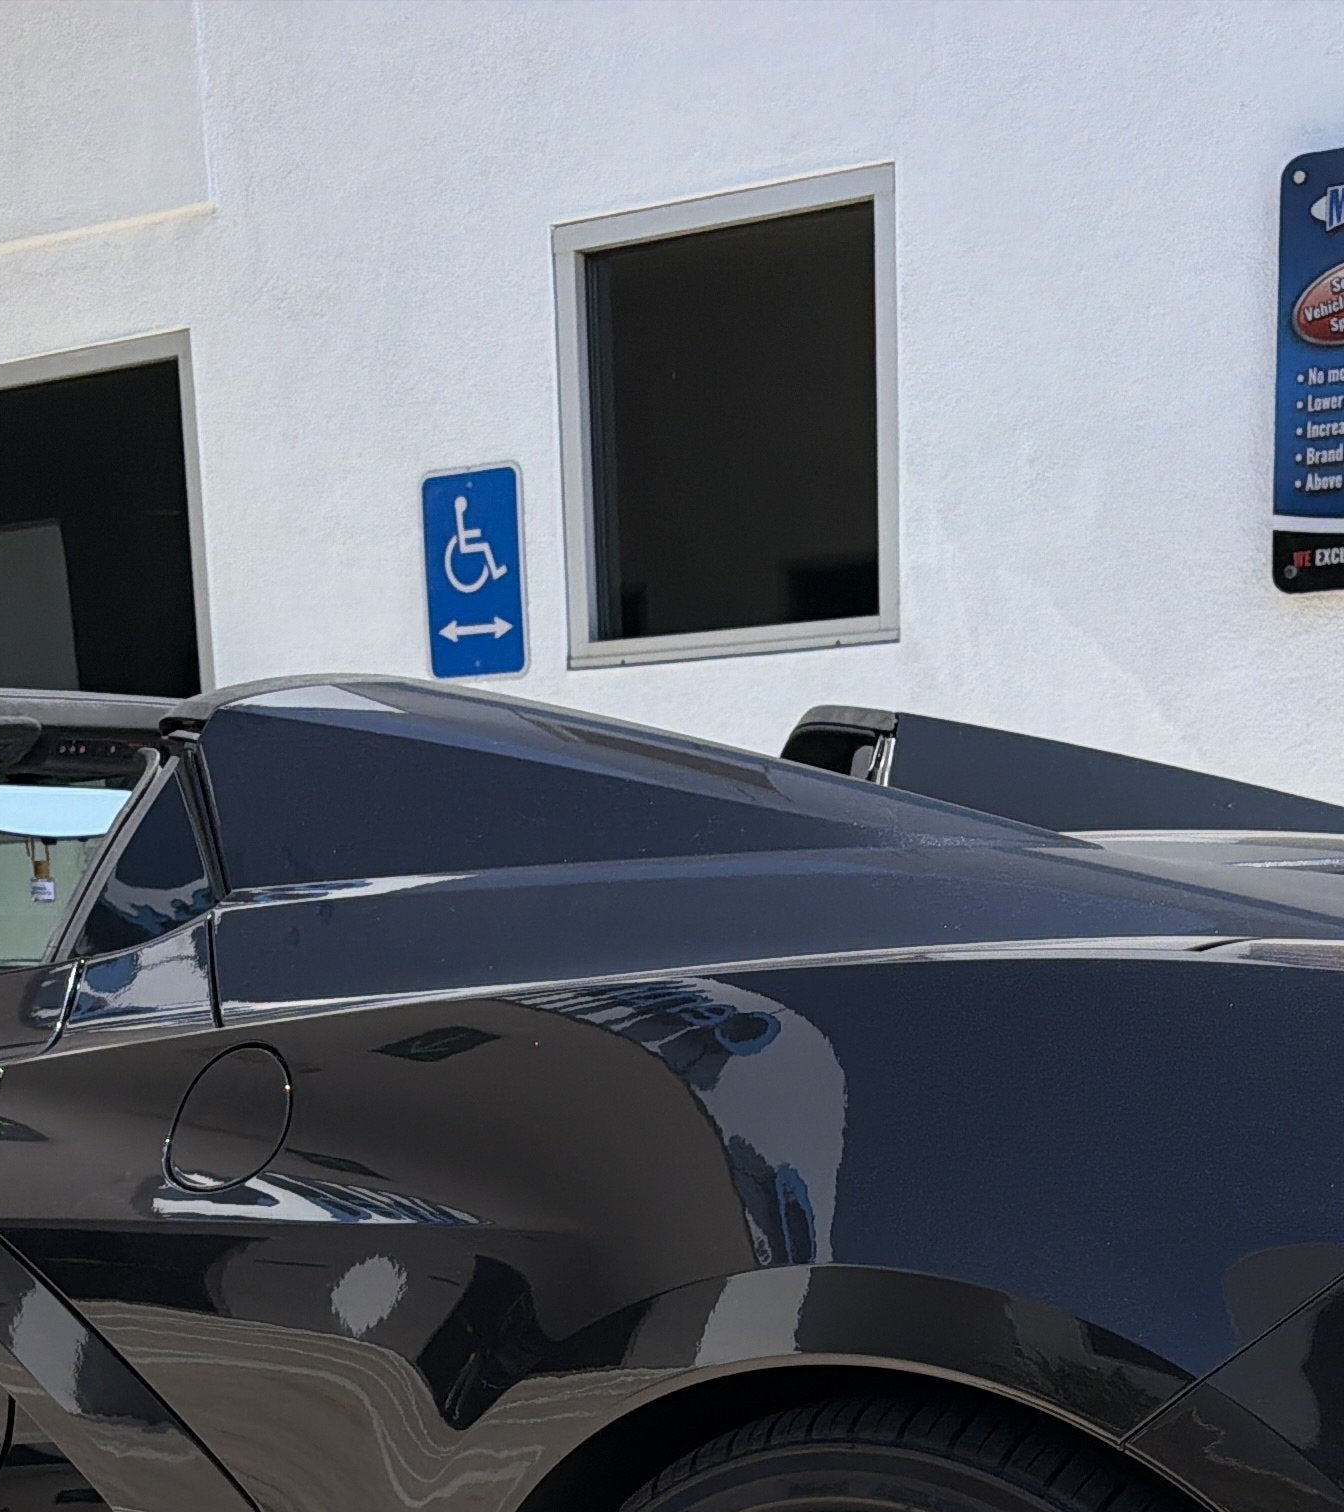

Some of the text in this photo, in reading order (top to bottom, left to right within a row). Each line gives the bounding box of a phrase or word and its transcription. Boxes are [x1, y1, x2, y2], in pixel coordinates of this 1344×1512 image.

[1308, 368, 1324, 385] No
[1307, 394, 1344, 412] Lower
[1306, 443, 1343, 465] Brand
[1306, 473, 1342, 491] Above
[1293, 551, 1312, 569] WE
